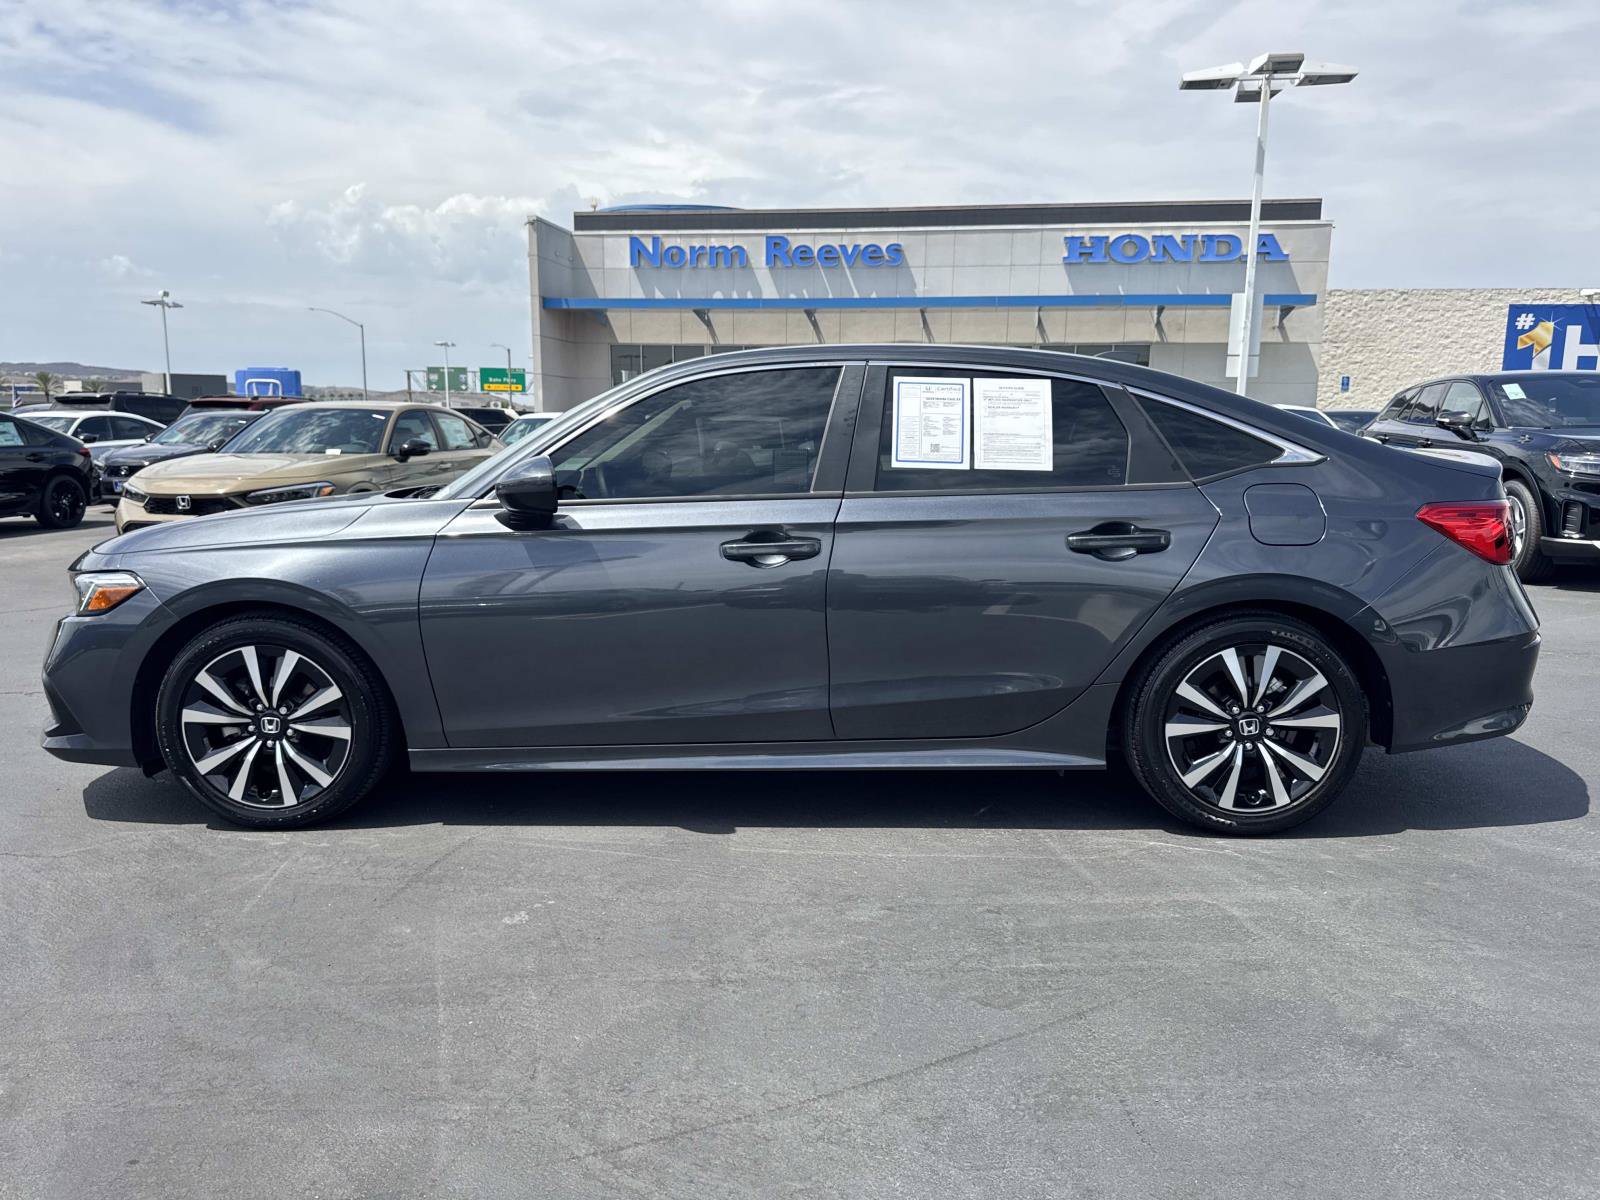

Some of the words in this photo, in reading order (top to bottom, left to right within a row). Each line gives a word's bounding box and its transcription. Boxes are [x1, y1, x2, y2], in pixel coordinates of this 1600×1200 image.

[629, 235, 747, 269] Norm
[765, 235, 904, 268] Reeves
[1062, 233, 1290, 264] HONDA
